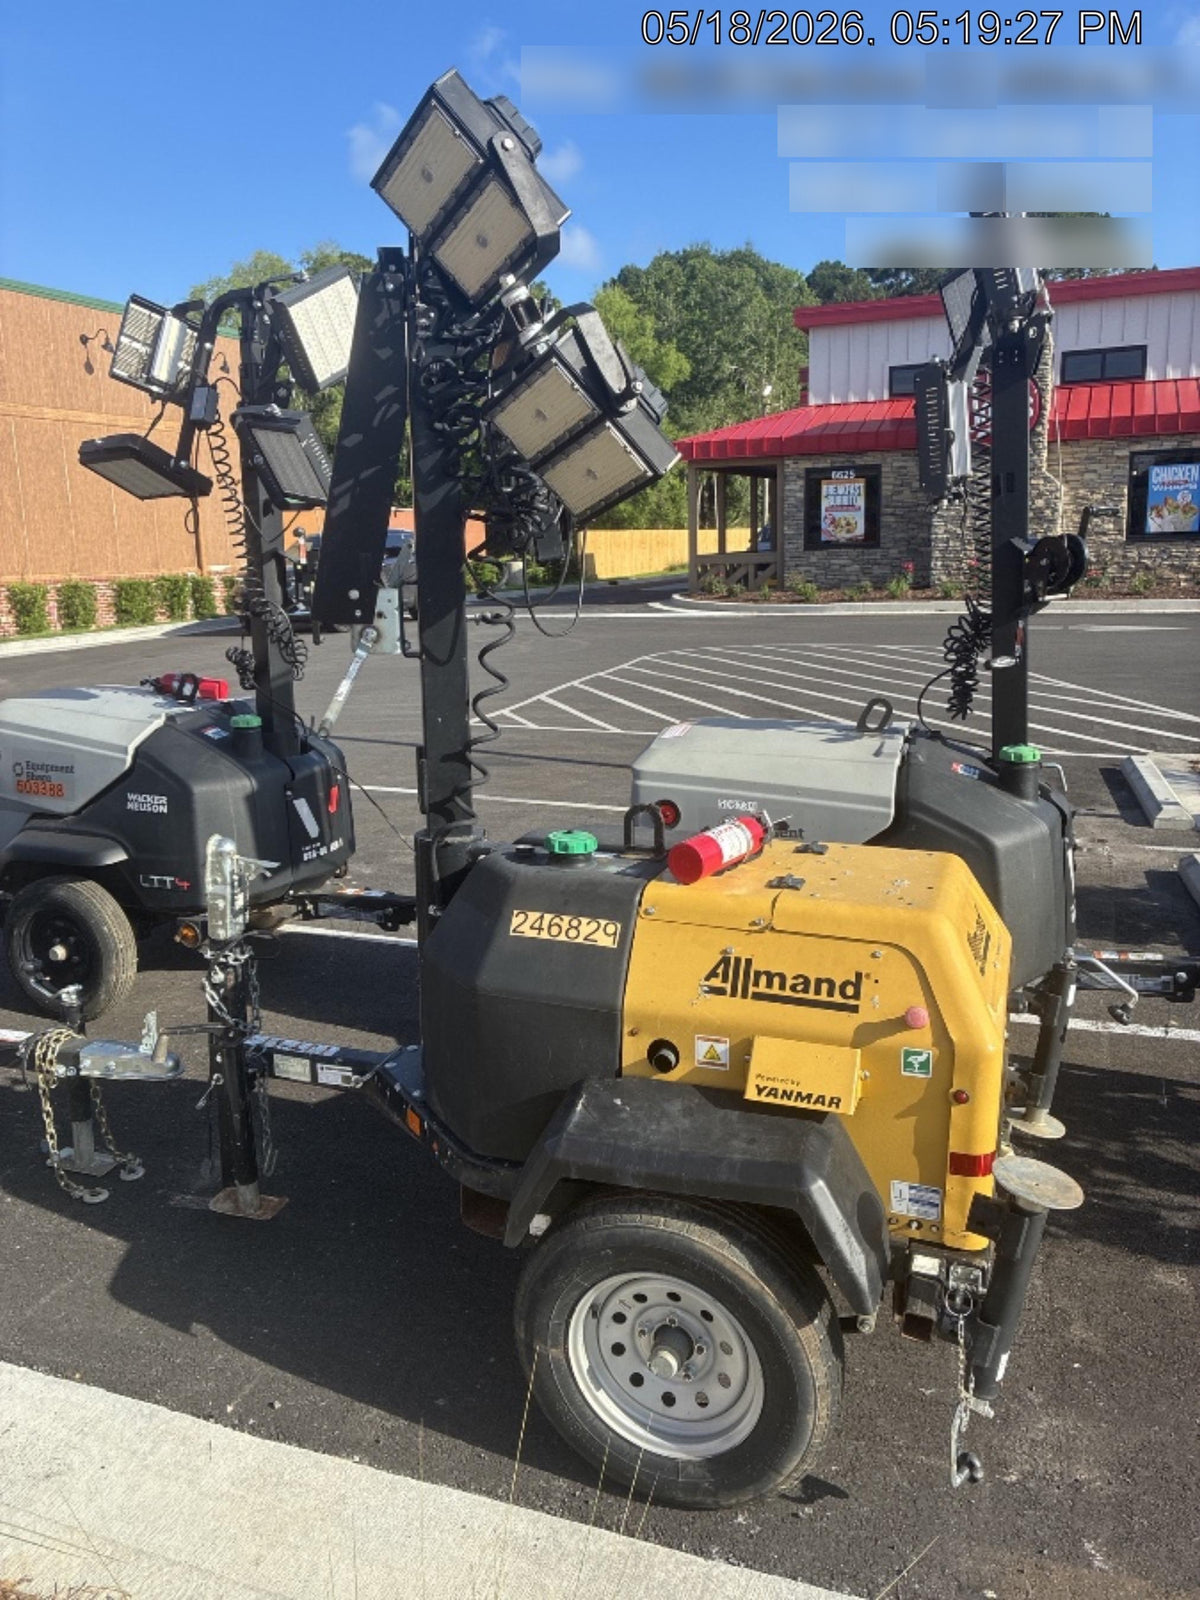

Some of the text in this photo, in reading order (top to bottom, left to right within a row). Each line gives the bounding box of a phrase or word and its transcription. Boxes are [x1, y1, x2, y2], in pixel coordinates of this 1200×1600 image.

[126, 802, 168, 814] NEUSON
[127, 792, 168, 804] WACKER
[511, 911, 619, 945] 246829
[703, 956, 863, 1003] Allmand
[755, 1084, 842, 1109] YANMAR
